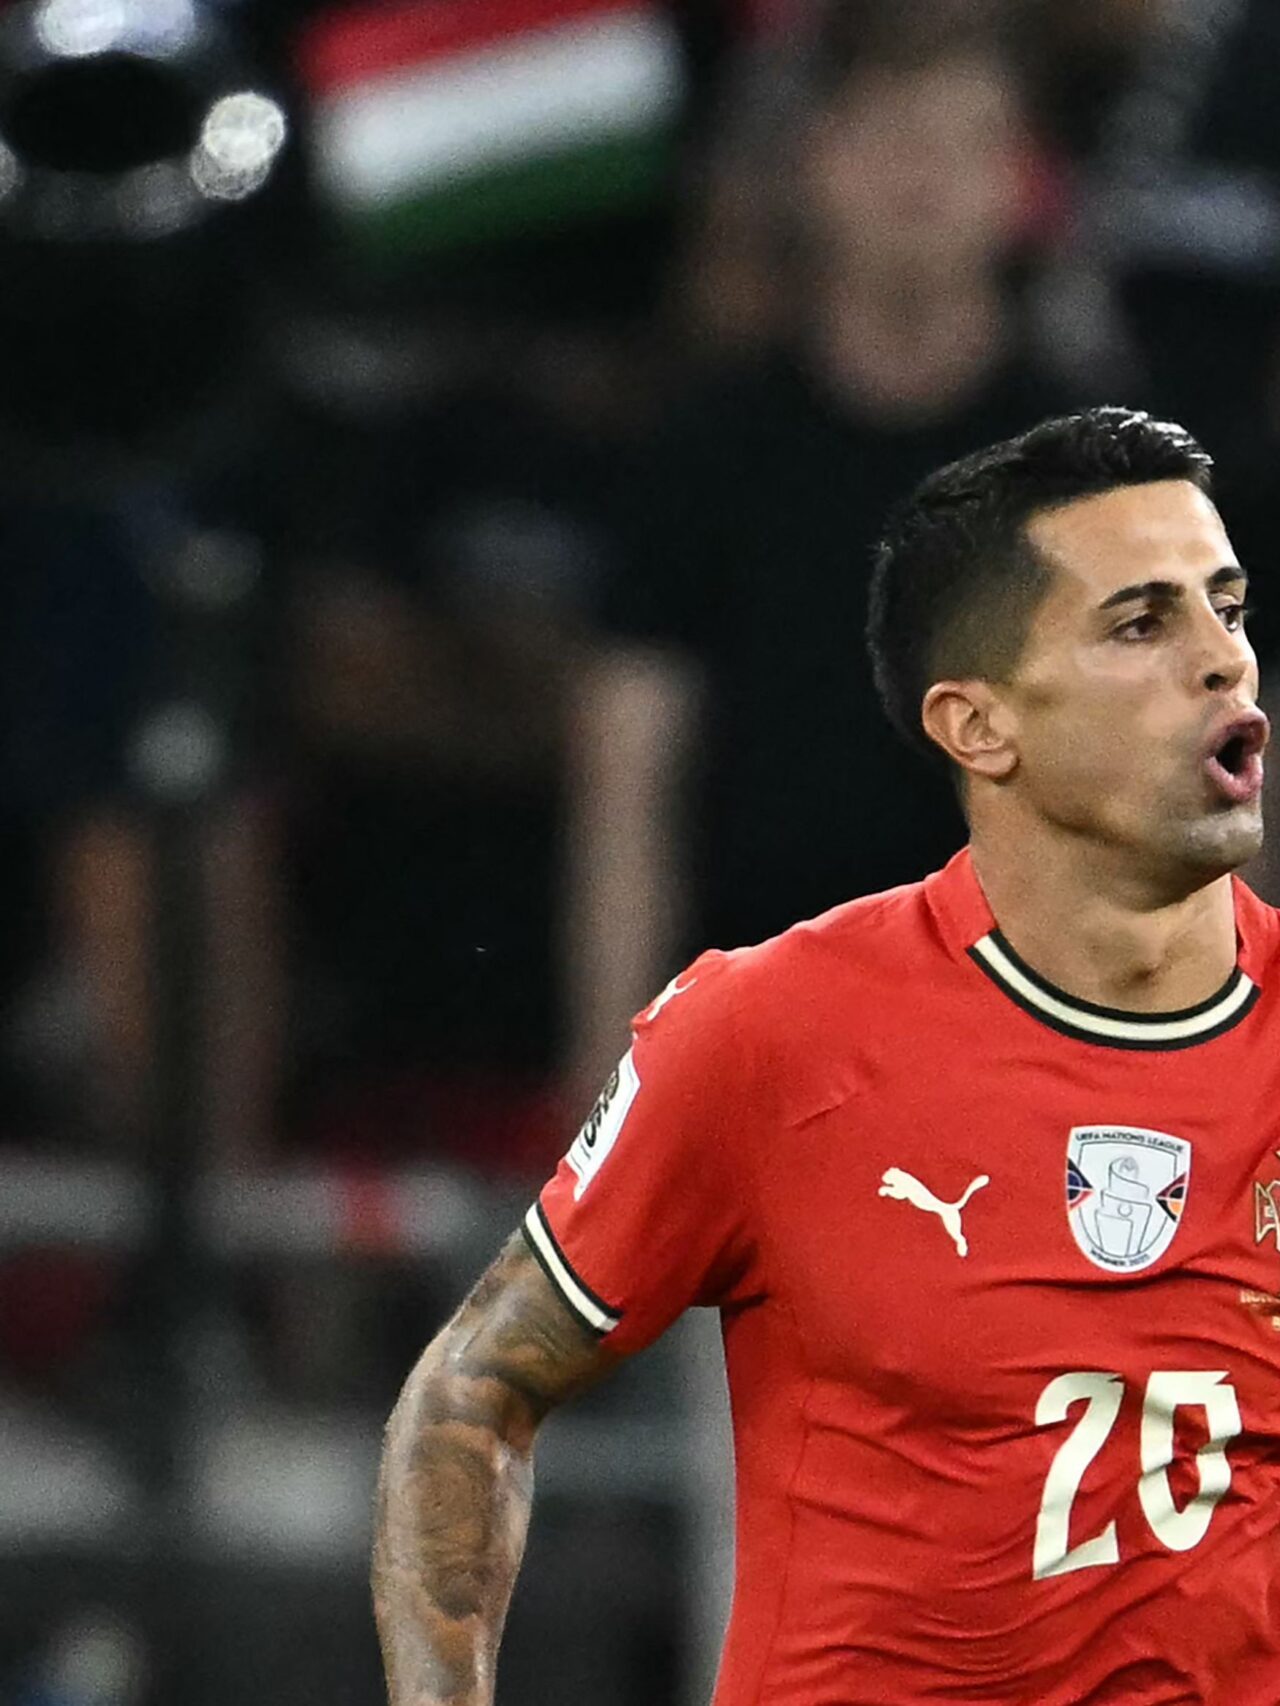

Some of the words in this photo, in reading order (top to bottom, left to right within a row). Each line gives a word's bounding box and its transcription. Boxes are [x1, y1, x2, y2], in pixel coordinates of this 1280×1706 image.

[1075, 1131, 1100, 1142] UEFA
[1102, 1132, 1145, 1143] NATIONS
[1147, 1136, 1184, 1152] LEAGUE
[1033, 1371, 1242, 1580] 20
